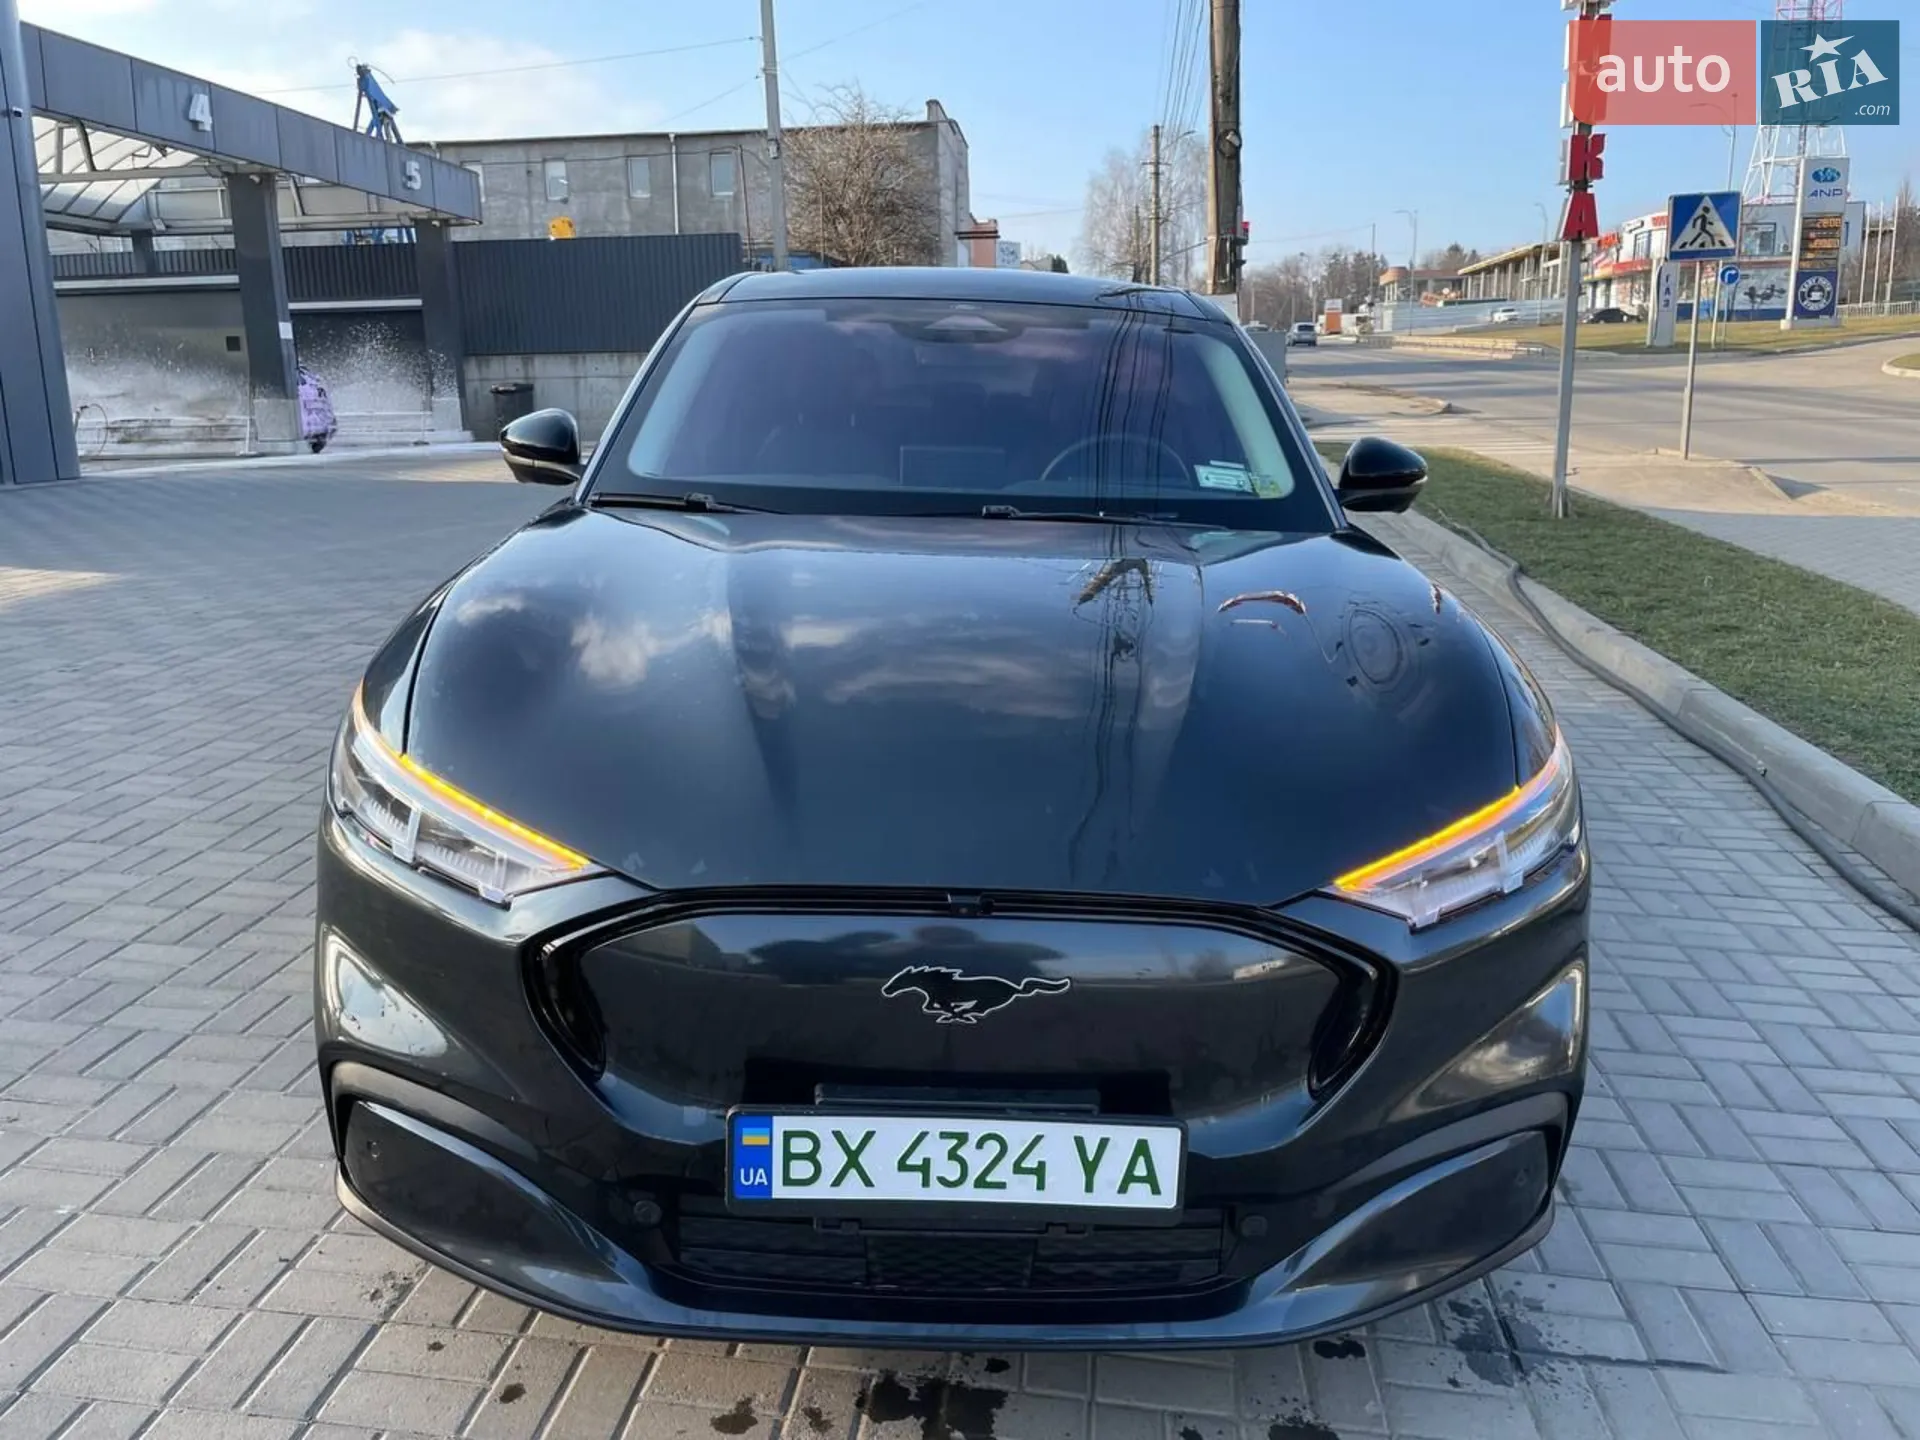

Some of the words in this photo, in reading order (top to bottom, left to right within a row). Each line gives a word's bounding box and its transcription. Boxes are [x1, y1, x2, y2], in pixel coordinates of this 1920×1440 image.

[189, 93, 212, 132] 4
[402, 160, 421, 190] 5
[1808, 188, 1843, 198] ANP
[740, 1168, 768, 1186] UA
[782, 1130, 876, 1188] BX
[897, 1130, 1046, 1191] 4324
[1073, 1135, 1162, 1196] YA
